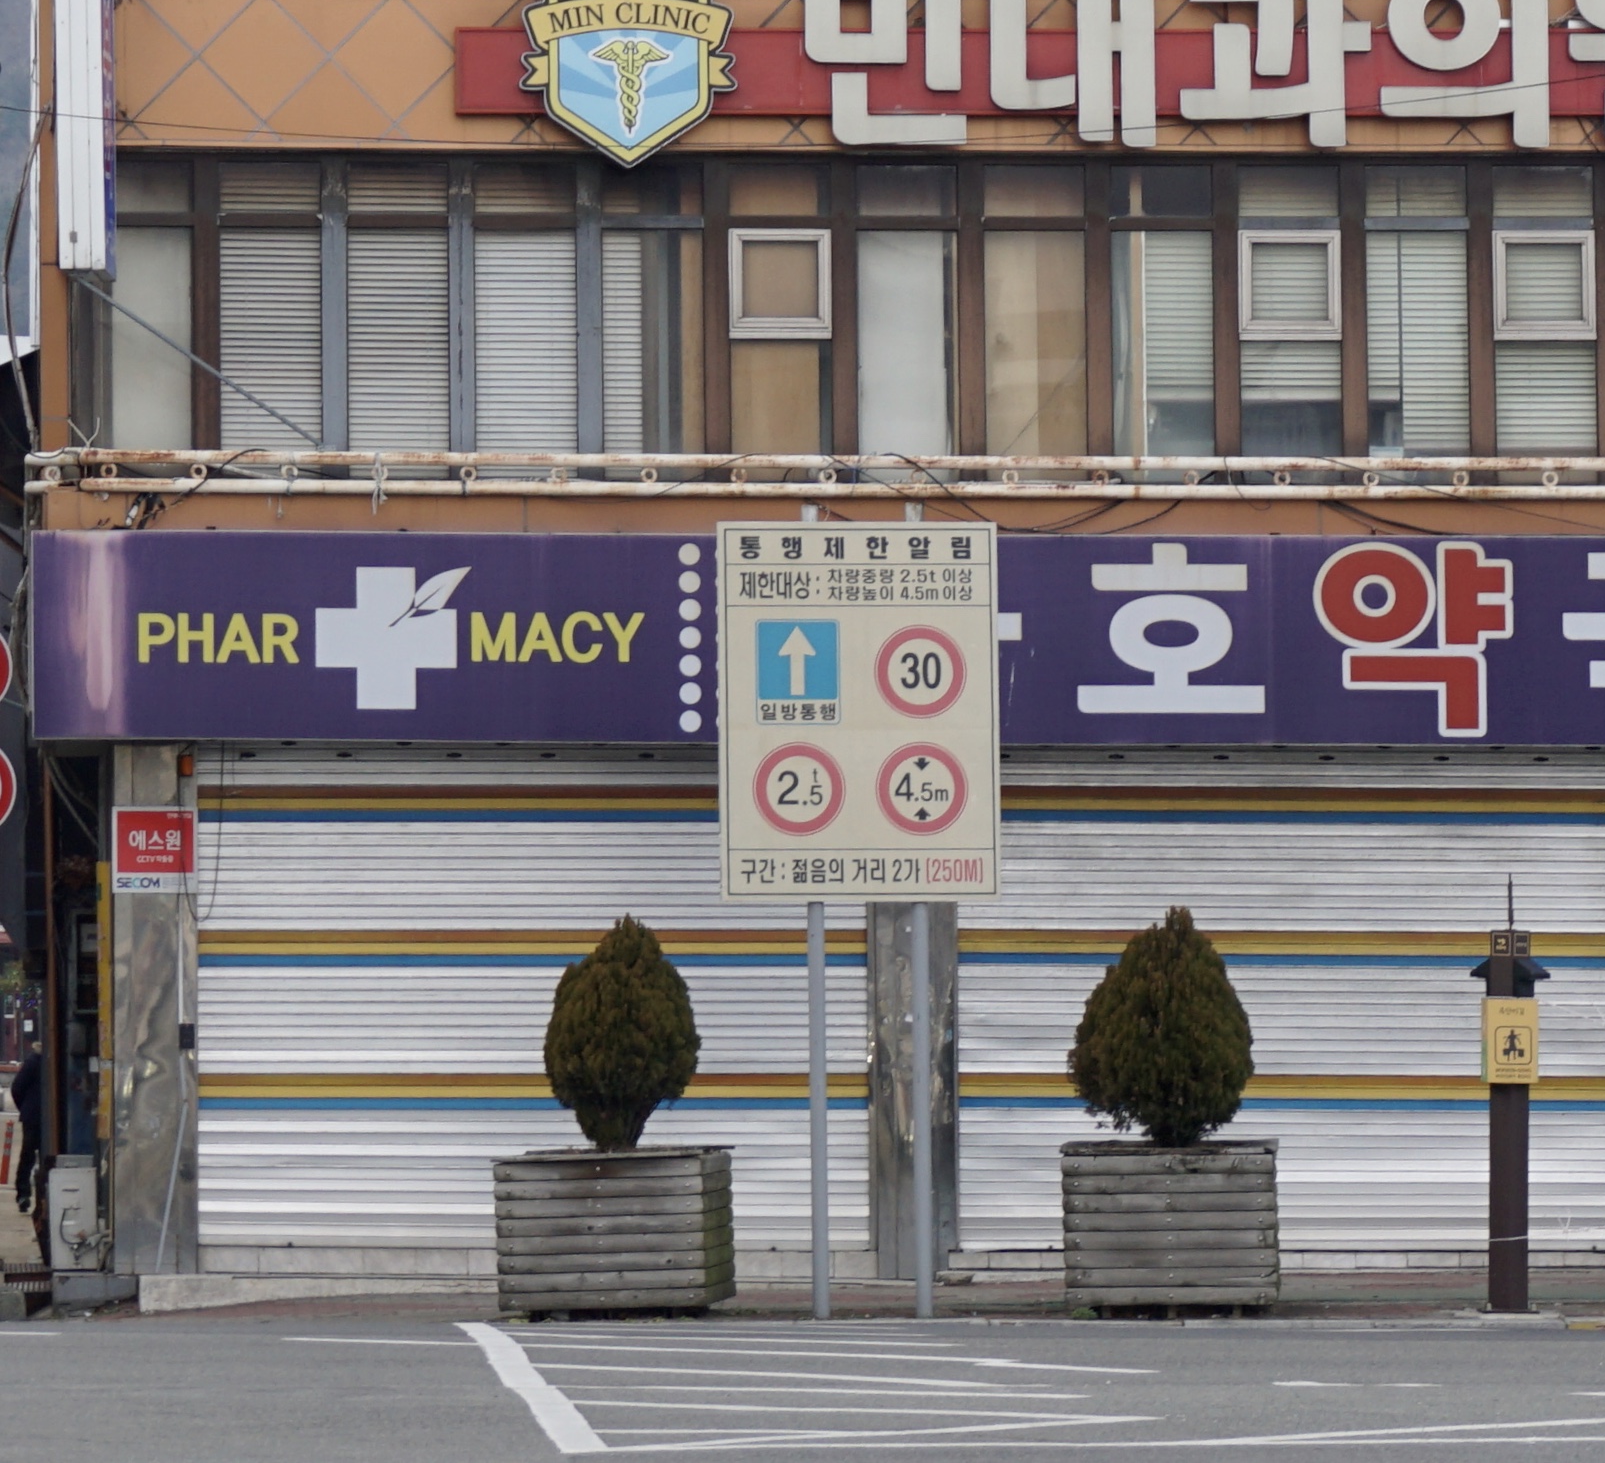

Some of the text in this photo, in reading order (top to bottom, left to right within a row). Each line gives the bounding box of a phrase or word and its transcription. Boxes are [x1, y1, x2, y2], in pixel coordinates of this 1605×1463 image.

[548, 0, 713, 37] MIN CLINIC
[827, 568, 895, 585] 차량중량
[901, 568, 936, 584] 2.5t
[942, 568, 973, 584] 이상
[827, 585, 973, 602] 차량높이 4.5m 이상
[136, 611, 645, 664] PHAR MACY
[900, 652, 942, 690] 30
[760, 702, 837, 721] 일방통행
[894, 772, 950, 803] 4.5m
[129, 828, 182, 851] 에스원
[116, 876, 160, 889] SECOM
[791, 857, 845, 885] 젊음의
[852, 857, 886, 885] 거리
[892, 857, 921, 885] 2가
